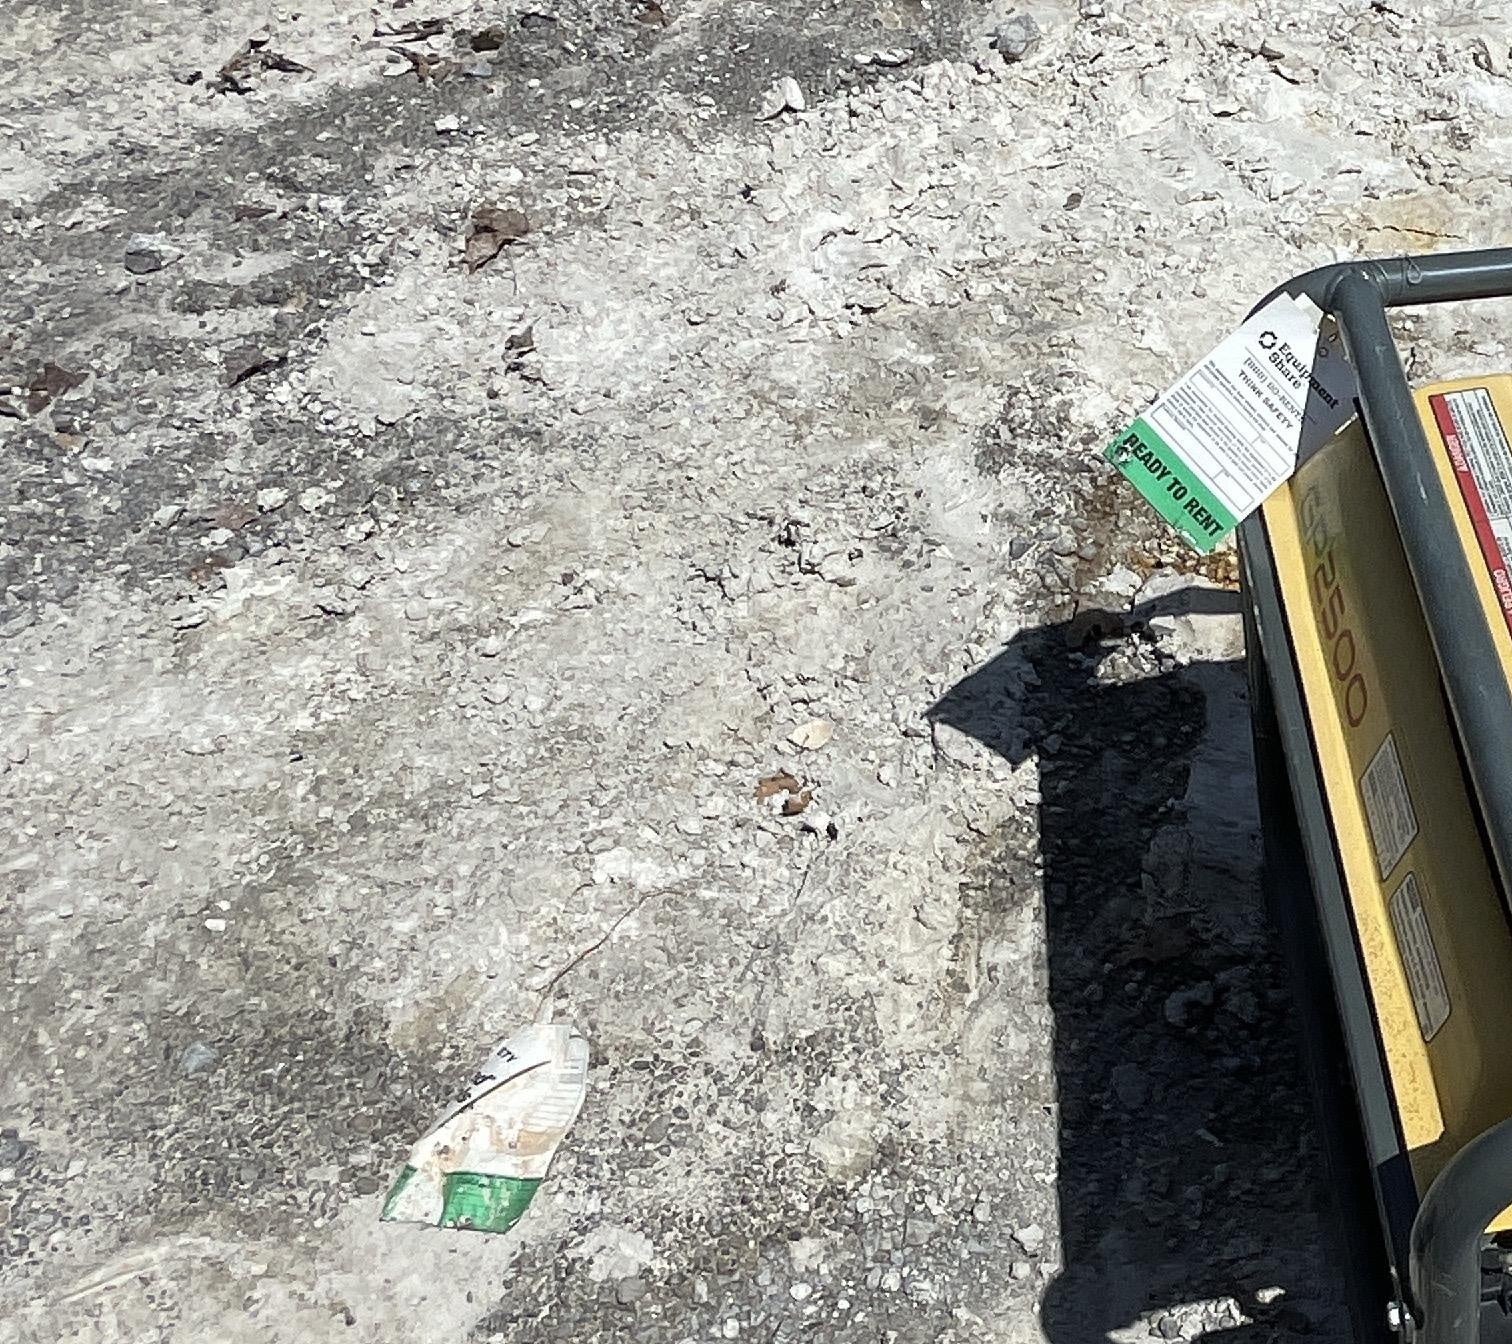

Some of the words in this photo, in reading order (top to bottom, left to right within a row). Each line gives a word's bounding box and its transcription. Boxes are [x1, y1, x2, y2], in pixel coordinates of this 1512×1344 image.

[1238, 369, 1262, 400] THINK
[1262, 397, 1294, 430] SAFETY
[1268, 352, 1301, 389] Share
[1278, 342, 1339, 409] Equipment
[1123, 432, 1171, 482] READY
[1166, 476, 1188, 502] TO
[1183, 497, 1225, 537] RENT
